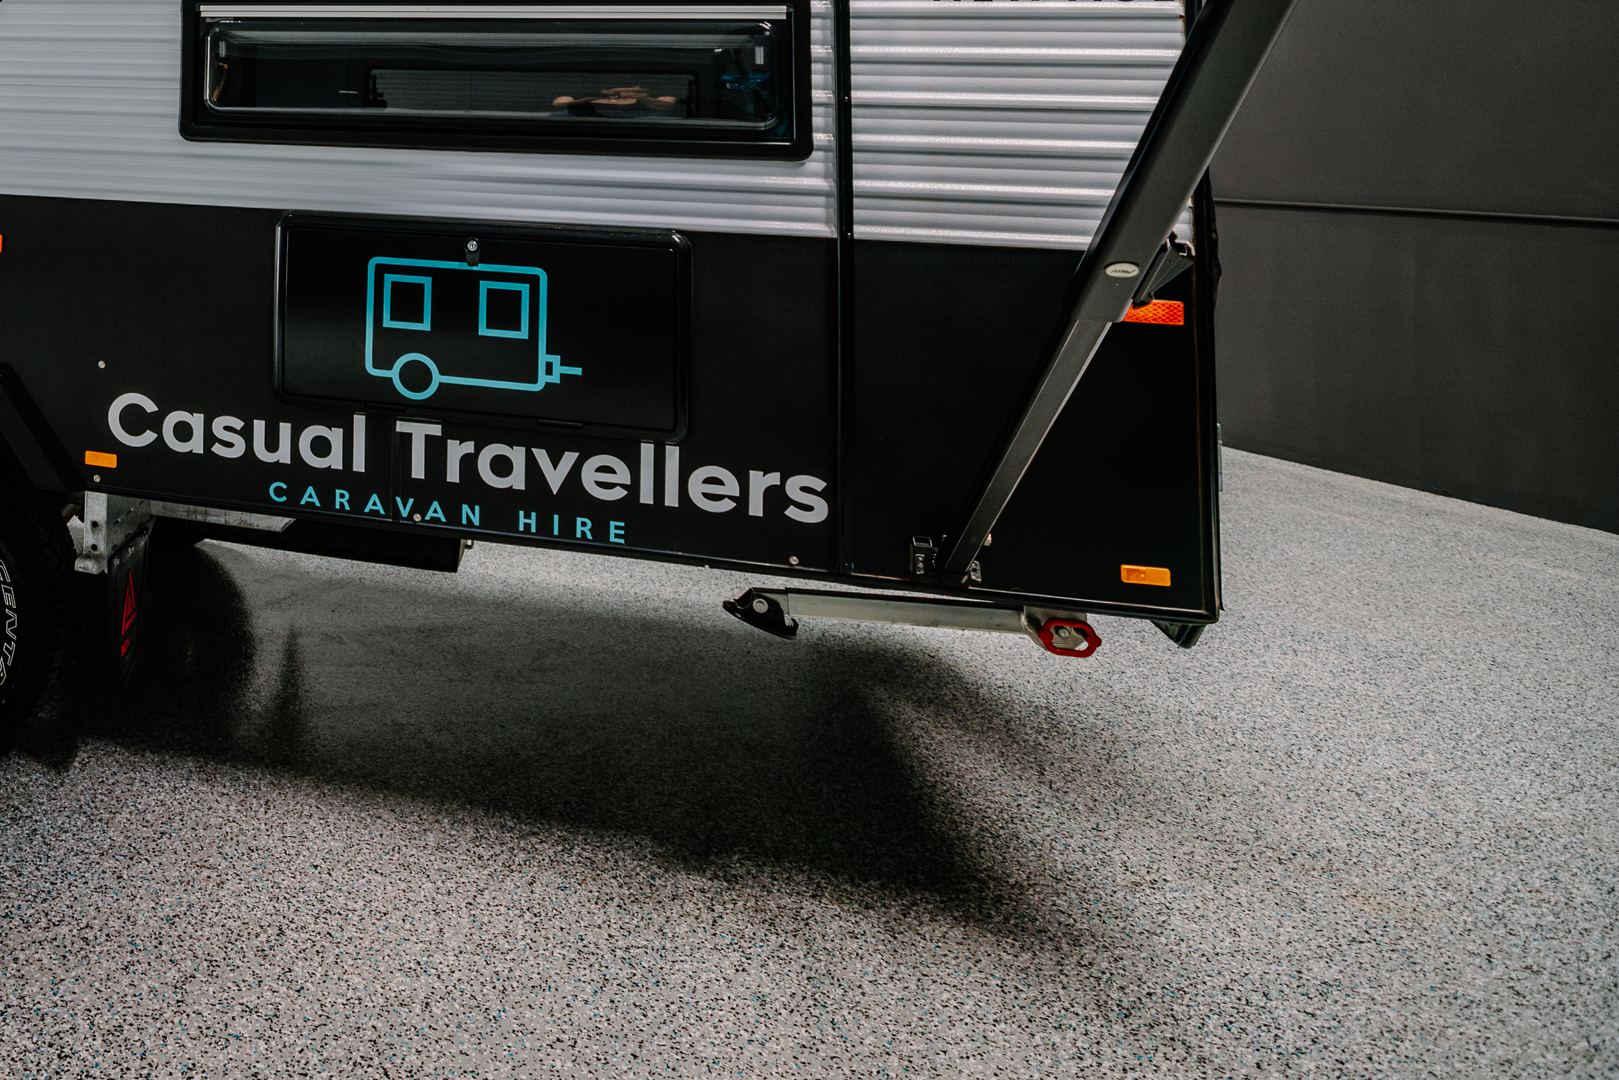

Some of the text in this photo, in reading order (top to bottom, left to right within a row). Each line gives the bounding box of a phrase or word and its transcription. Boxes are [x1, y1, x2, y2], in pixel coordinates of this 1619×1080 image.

[106, 391, 830, 525] Casual Travellers
[268, 480, 627, 545] CARAVAN HIRE
